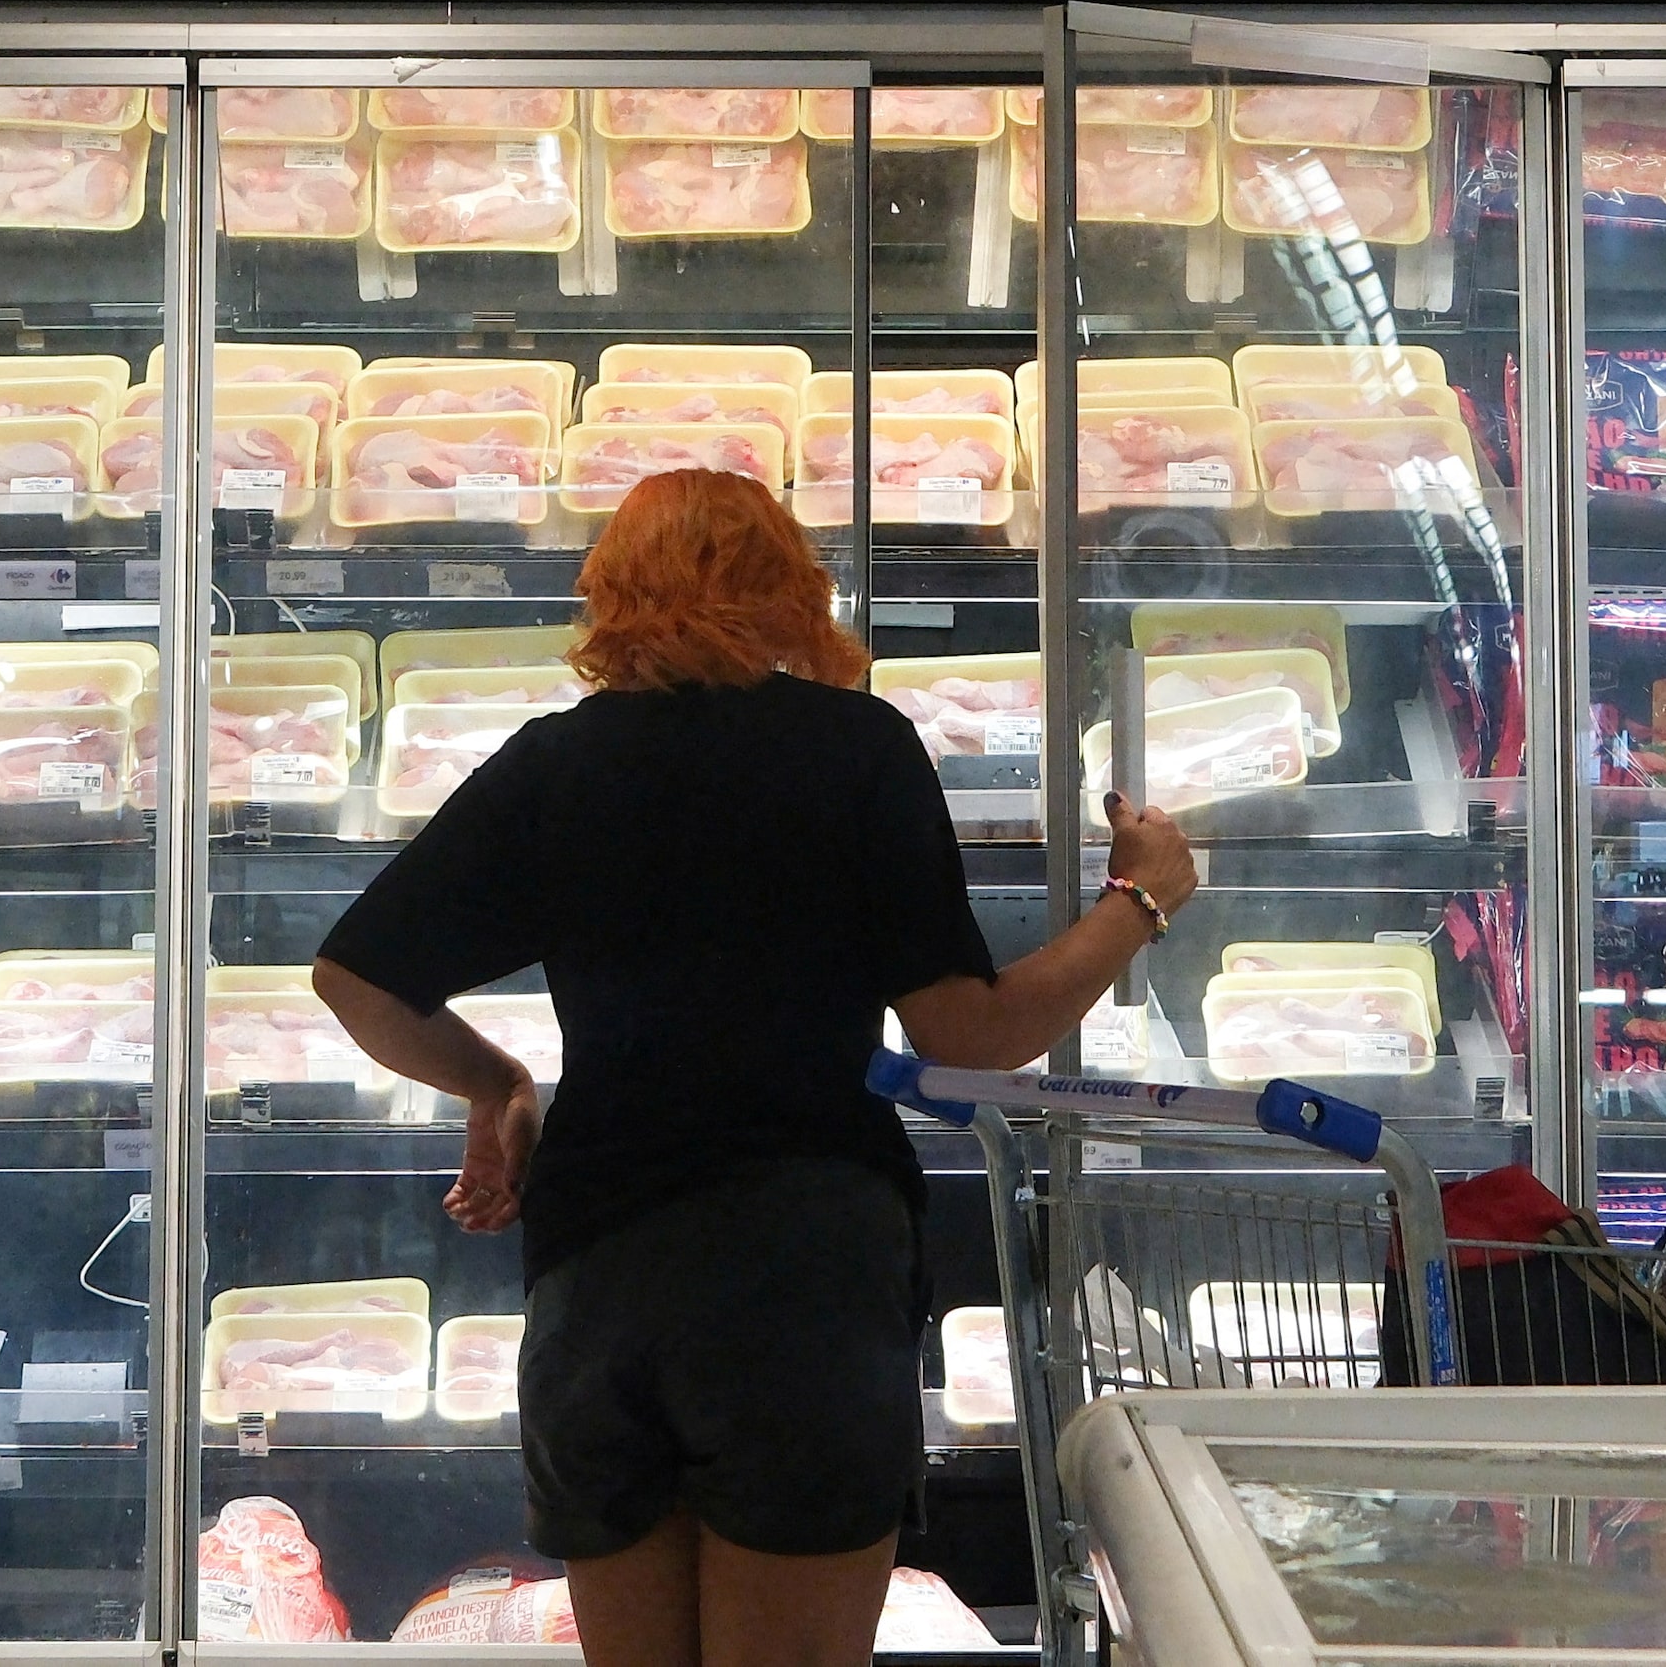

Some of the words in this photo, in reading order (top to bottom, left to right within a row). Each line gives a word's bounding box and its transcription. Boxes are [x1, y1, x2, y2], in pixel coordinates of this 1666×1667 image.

[413, 1605, 460, 1628] FRANGO
[427, 1618, 470, 1637] MOELA,
[473, 1614, 481, 1629] 2
